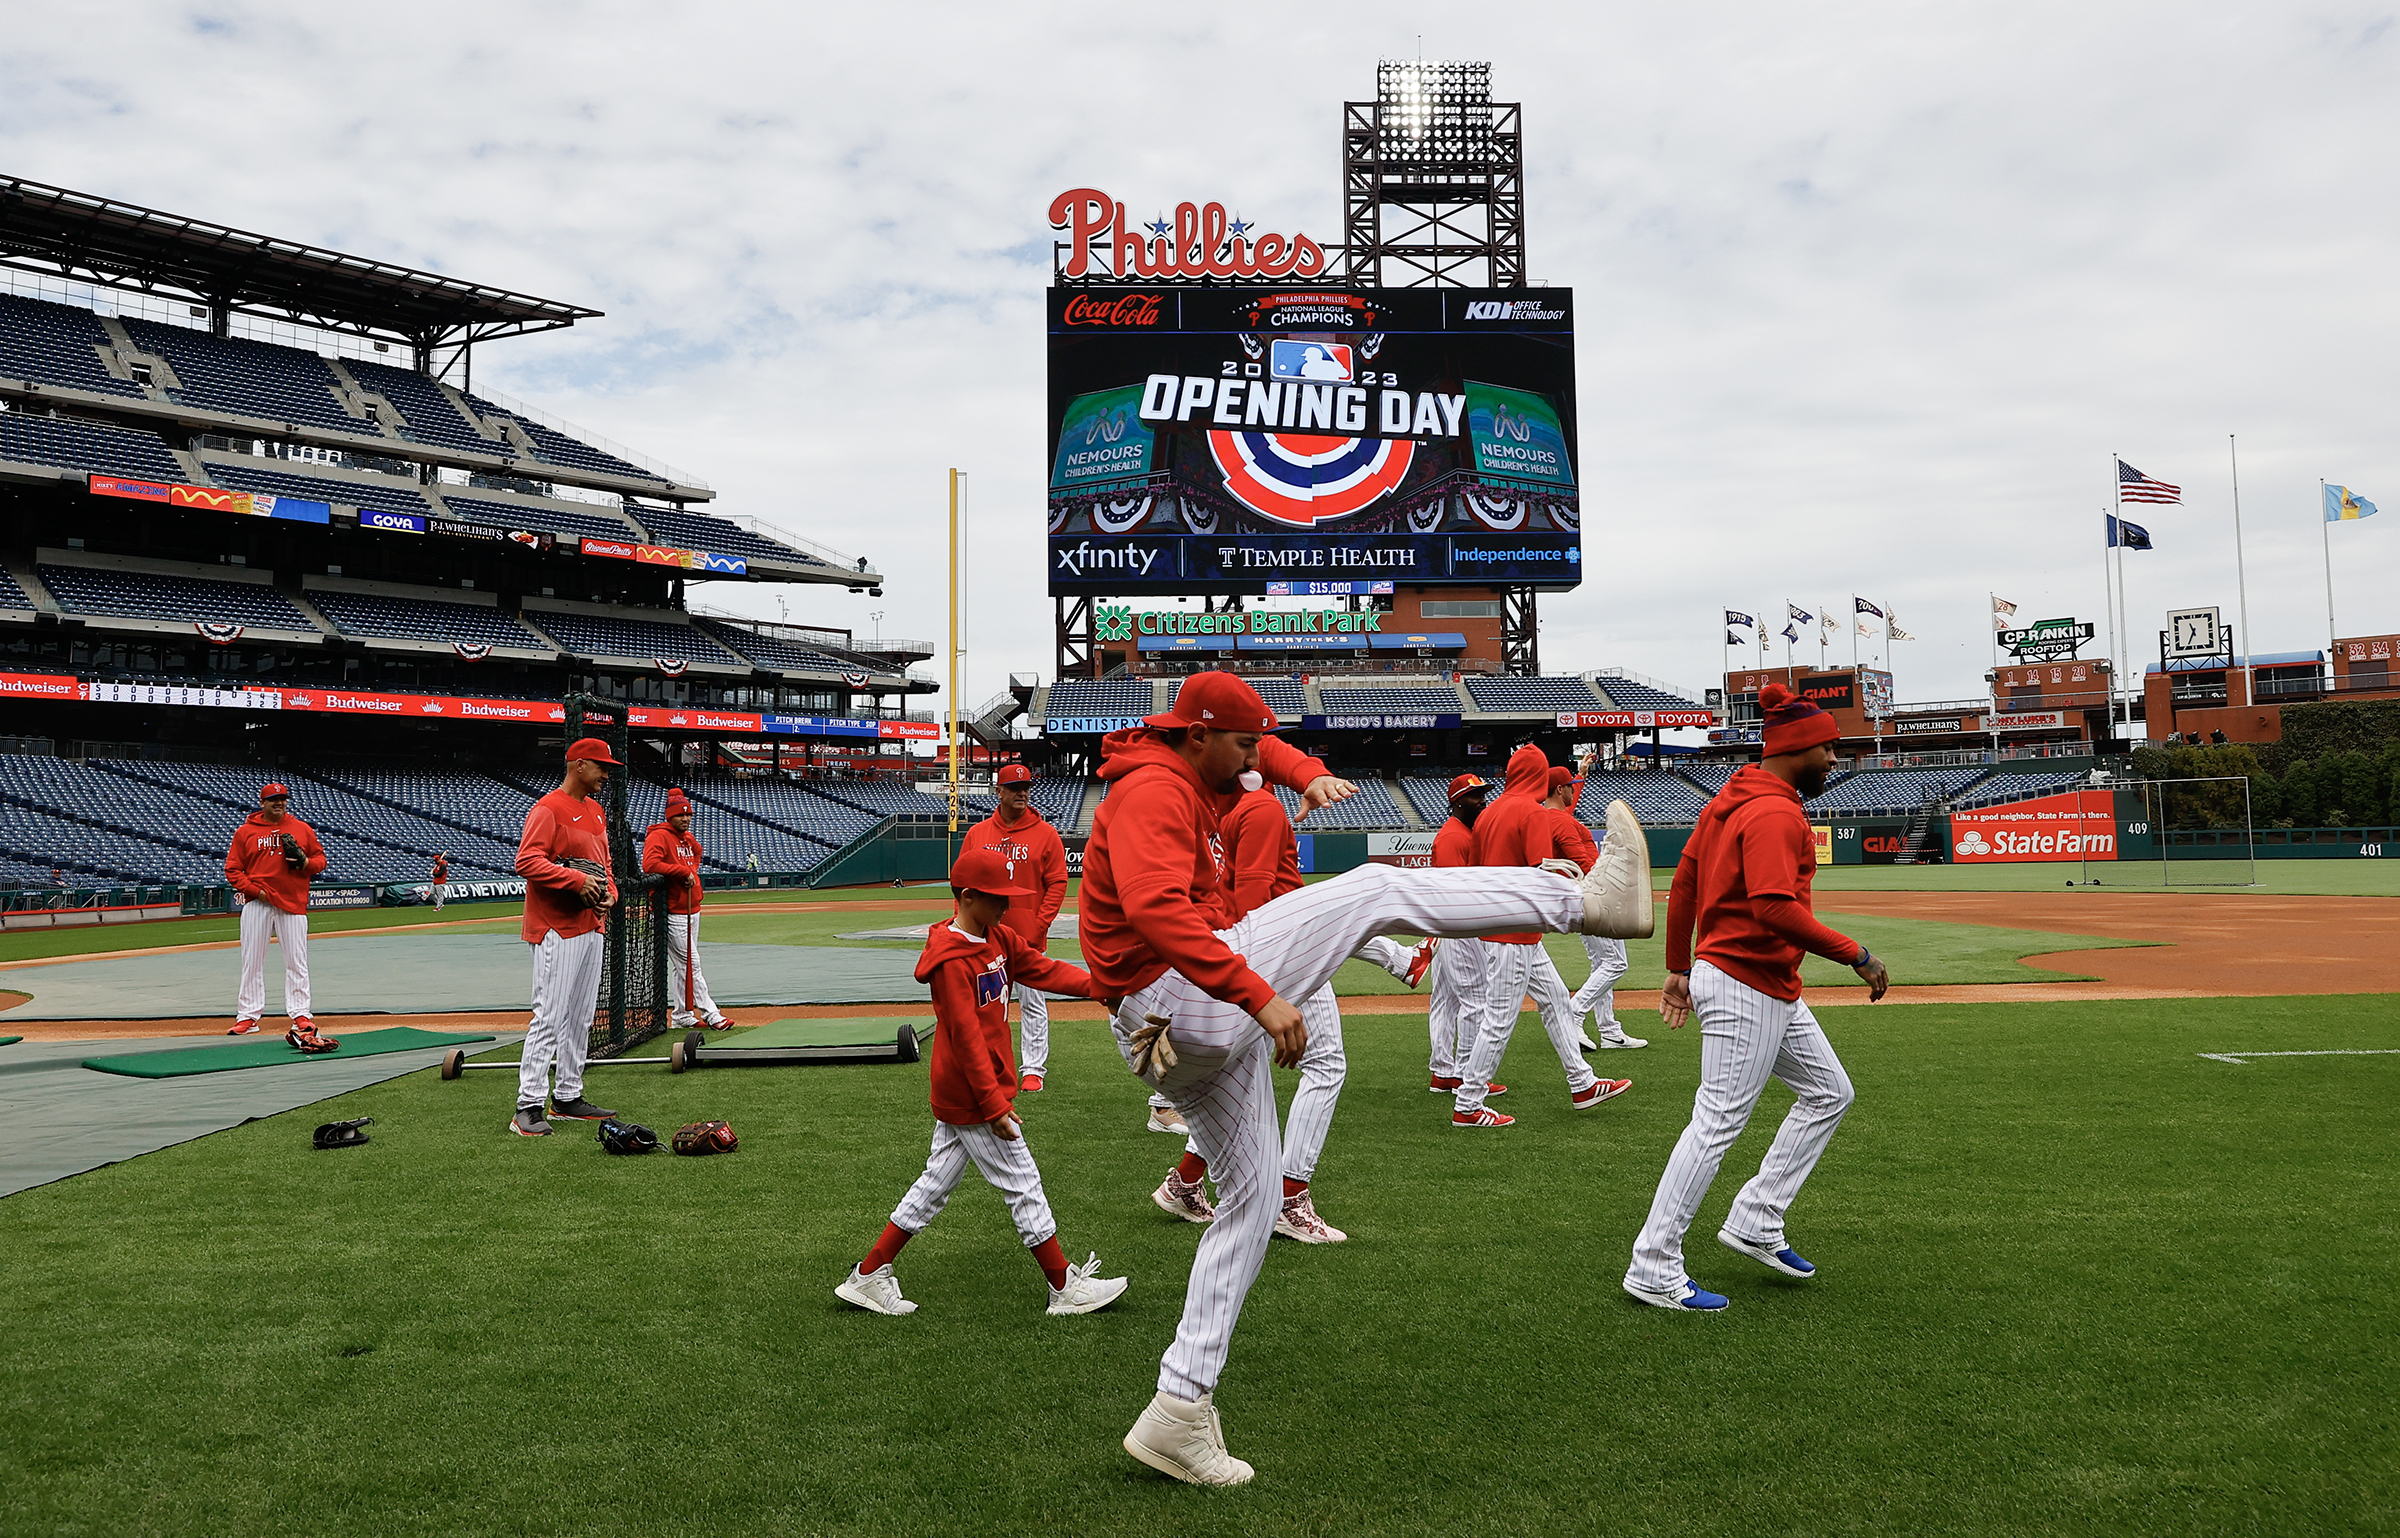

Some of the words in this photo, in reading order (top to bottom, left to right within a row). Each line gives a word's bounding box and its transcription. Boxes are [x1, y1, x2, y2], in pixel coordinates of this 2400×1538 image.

[1047, 186, 1326, 279] Phillies
[1275, 295, 1320, 304] PHILADELPHIA
[1321, 295, 1348, 304] PHILLIES
[1514, 301, 1543, 310] OFFICE
[1064, 294, 1165, 326] Coca-Cola
[1281, 305, 1317, 313] NATIONAL
[1318, 305, 1345, 313] LEAGUE
[1511, 310, 1566, 320] TECHNOLOGY
[1271, 313, 1354, 326] CHAMPIONS
[1139, 374, 1367, 432] OPENING
[1378, 389, 1467, 438] DAY
[1067, 444, 1143, 466] NEMOURS
[1481, 442, 1557, 464] NEMOURS
[1065, 462, 1111, 478] CHILDREN'S
[1110, 459, 1142, 473] HEALTH
[1483, 457, 1531, 473] CHILDREN'S
[1531, 461, 1560, 476] HEALTH
[116, 483, 168, 496] AMAZING
[373, 514, 414, 529] GOYA
[1057, 540, 1158, 576] xfinity
[1239, 548, 1325, 567] TEMPLE
[1328, 547, 1416, 567] HEALTH
[1454, 546, 1562, 565] Independence
[1309, 582, 1352, 595] $15,000
[1998, 602, 2009, 612] 28
[1138, 610, 1246, 634] Citizens
[1250, 608, 1319, 633] Bank
[1322, 607, 1382, 632] Park
[1728, 612, 1747, 623] 1915
[1254, 636, 1304, 644] HARRY
[2004, 631, 2026, 644] CP
[2028, 625, 2086, 641] RANKIN
[2020, 643, 2071, 655] ROOFTOP
[2349, 643, 2365, 656] 32
[2371, 641, 2389, 655] 34
[2026, 669, 2040, 681] 14
[2049, 667, 2062, 679] 15
[2071, 665, 2086, 677] 20
[0, 679, 72, 694] udweiser
[113, 685, 119, 693] 0
[131, 686, 137, 694] 0
[148, 687, 154, 695] 0
[165, 688, 171, 696] 0
[182, 688, 188, 696] 0
[199, 689, 205, 697] 0
[215, 690, 221, 698] 0
[231, 691, 237, 699] 0
[259, 692, 265, 700] 4
[1803, 685, 1849, 699] GIANT
[95, 693, 101, 701] 3
[113, 693, 119, 701] 0
[130, 694, 136, 702] 0
[147, 695, 153, 703] 0
[165, 696, 171, 704] 0
[182, 696, 188, 704] 0
[199, 697, 205, 705] 0
[215, 698, 221, 706] 0
[246, 699, 252, 707] 3
[259, 700, 265, 708] 2
[325, 694, 403, 712] Budweiser
[461, 702, 531, 718] Budweiser
[696, 714, 754, 728] Budweiser
[775, 716, 793, 724] PITCH
[794, 717, 812, 725] BREAK
[829, 718, 847, 727] PITCH
[847, 719, 861, 728] TYPE
[1048, 718, 1141, 731] DENTISTRY
[1326, 716, 1382, 728] LISCIO'S
[1384, 715, 1437, 728] BAKERY
[1580, 714, 1631, 725] TOYOTA
[1658, 713, 1709, 724] TOYOTA
[2017, 714, 2056, 723] LUKE'S
[899, 725, 938, 737] Budweiser
[1955, 812, 1972, 822] Like
[1980, 812, 1999, 823] good
[2001, 811, 2036, 822] neighbor,
[2037, 811, 2057, 820] State
[2058, 811, 2078, 820] Farm
[2088, 810, 2111, 819] there.
[1837, 827, 1856, 840] 387
[2128, 822, 2148, 835] 409
[258, 837, 282, 849] PHILL
[1388, 835, 1432, 854] Yueng
[2360, 843, 2382, 856] 401
[442, 883, 470, 899] MLB
[469, 881, 527, 898] NETWOR
[315, 898, 344, 906] LOCATION
